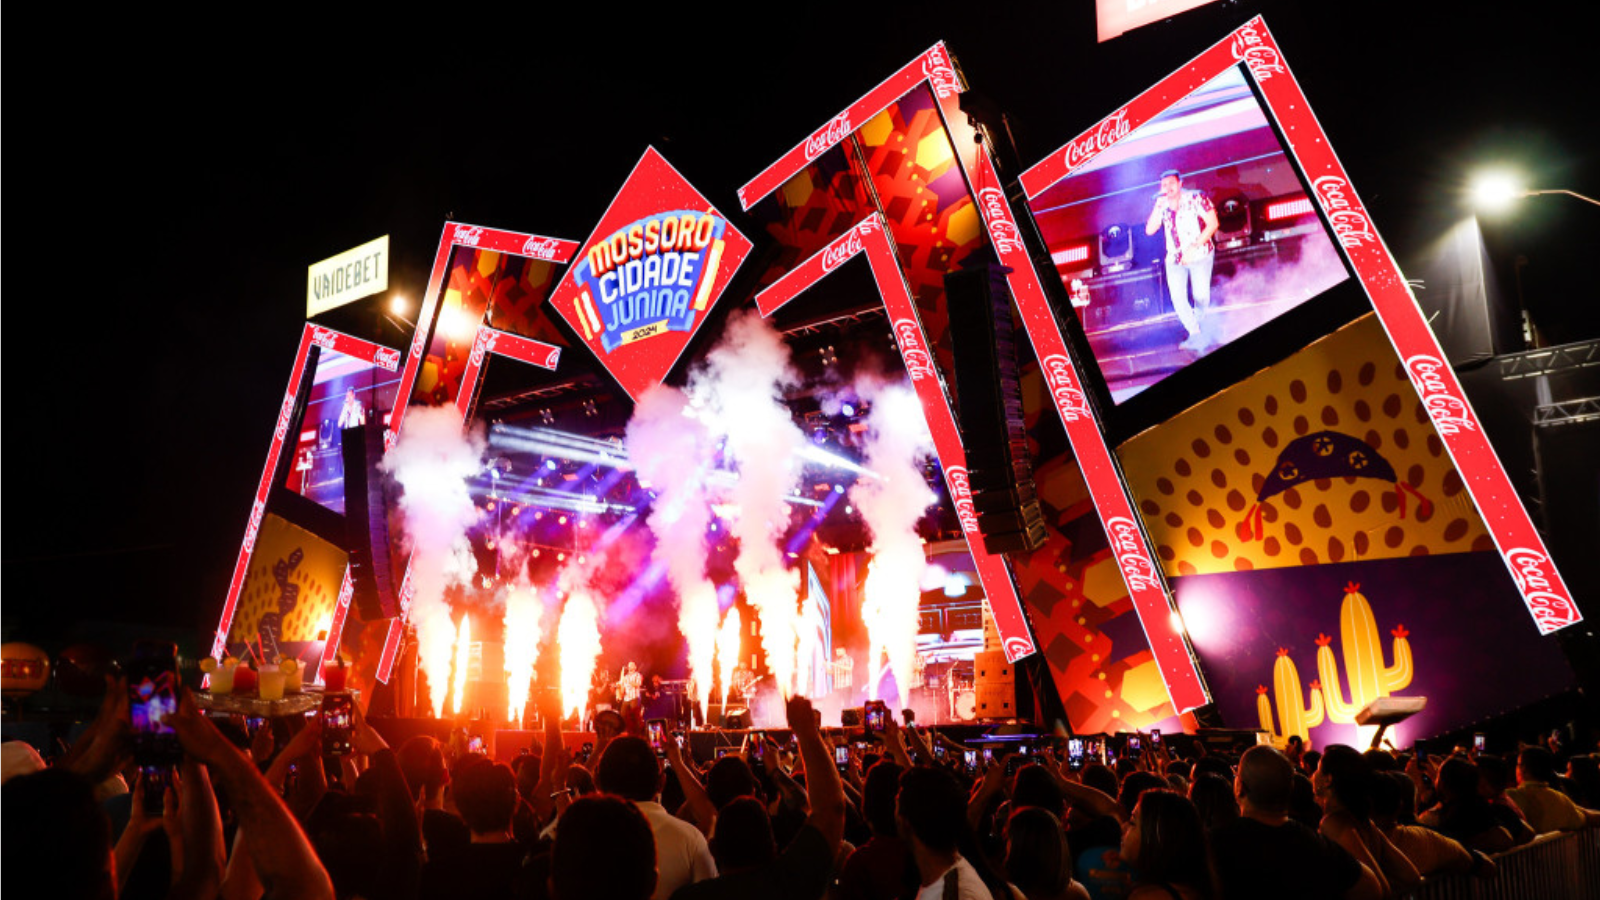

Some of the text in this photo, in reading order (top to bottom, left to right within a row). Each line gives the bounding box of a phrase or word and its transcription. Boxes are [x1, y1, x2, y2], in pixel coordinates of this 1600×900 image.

[588, 207, 715, 278] MOSSORÓ
[314, 252, 381, 300] VAIDEBET
[599, 252, 700, 305] CIDADE
[607, 288, 690, 332] JUNINA
[632, 325, 658, 341] 2024
